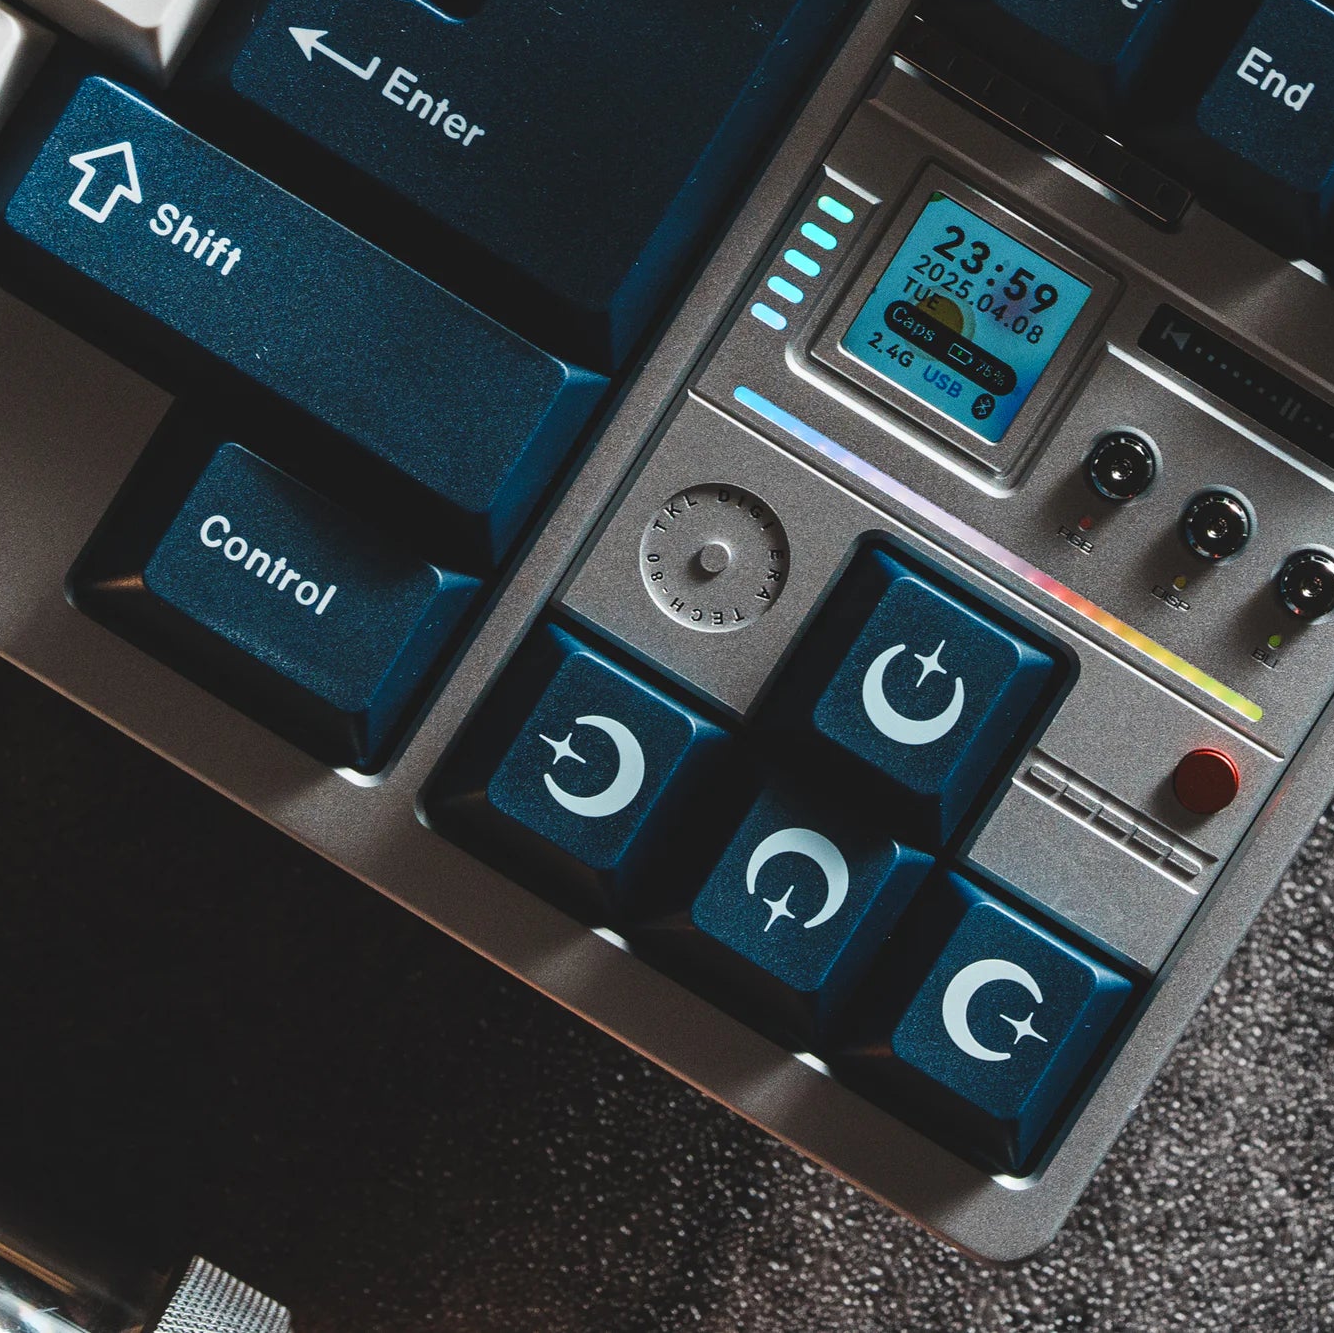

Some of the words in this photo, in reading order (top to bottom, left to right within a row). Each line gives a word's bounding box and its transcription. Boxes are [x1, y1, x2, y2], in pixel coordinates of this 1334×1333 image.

[381, 66, 485, 147] Enter
[1236, 46, 1315, 112] End
[149, 203, 242, 276] Shift
[932, 225, 1059, 315] 23:59
[892, 306, 936, 342] Caps
[902, 275, 940, 311] TUE
[913, 254, 1044, 345] 2025.04.08
[868, 332, 915, 368] 2.4G
[923, 364, 963, 399] USB
[652, 494, 699, 534] TKL
[199, 514, 337, 616] Control
[755, 549, 783, 602] ERA
